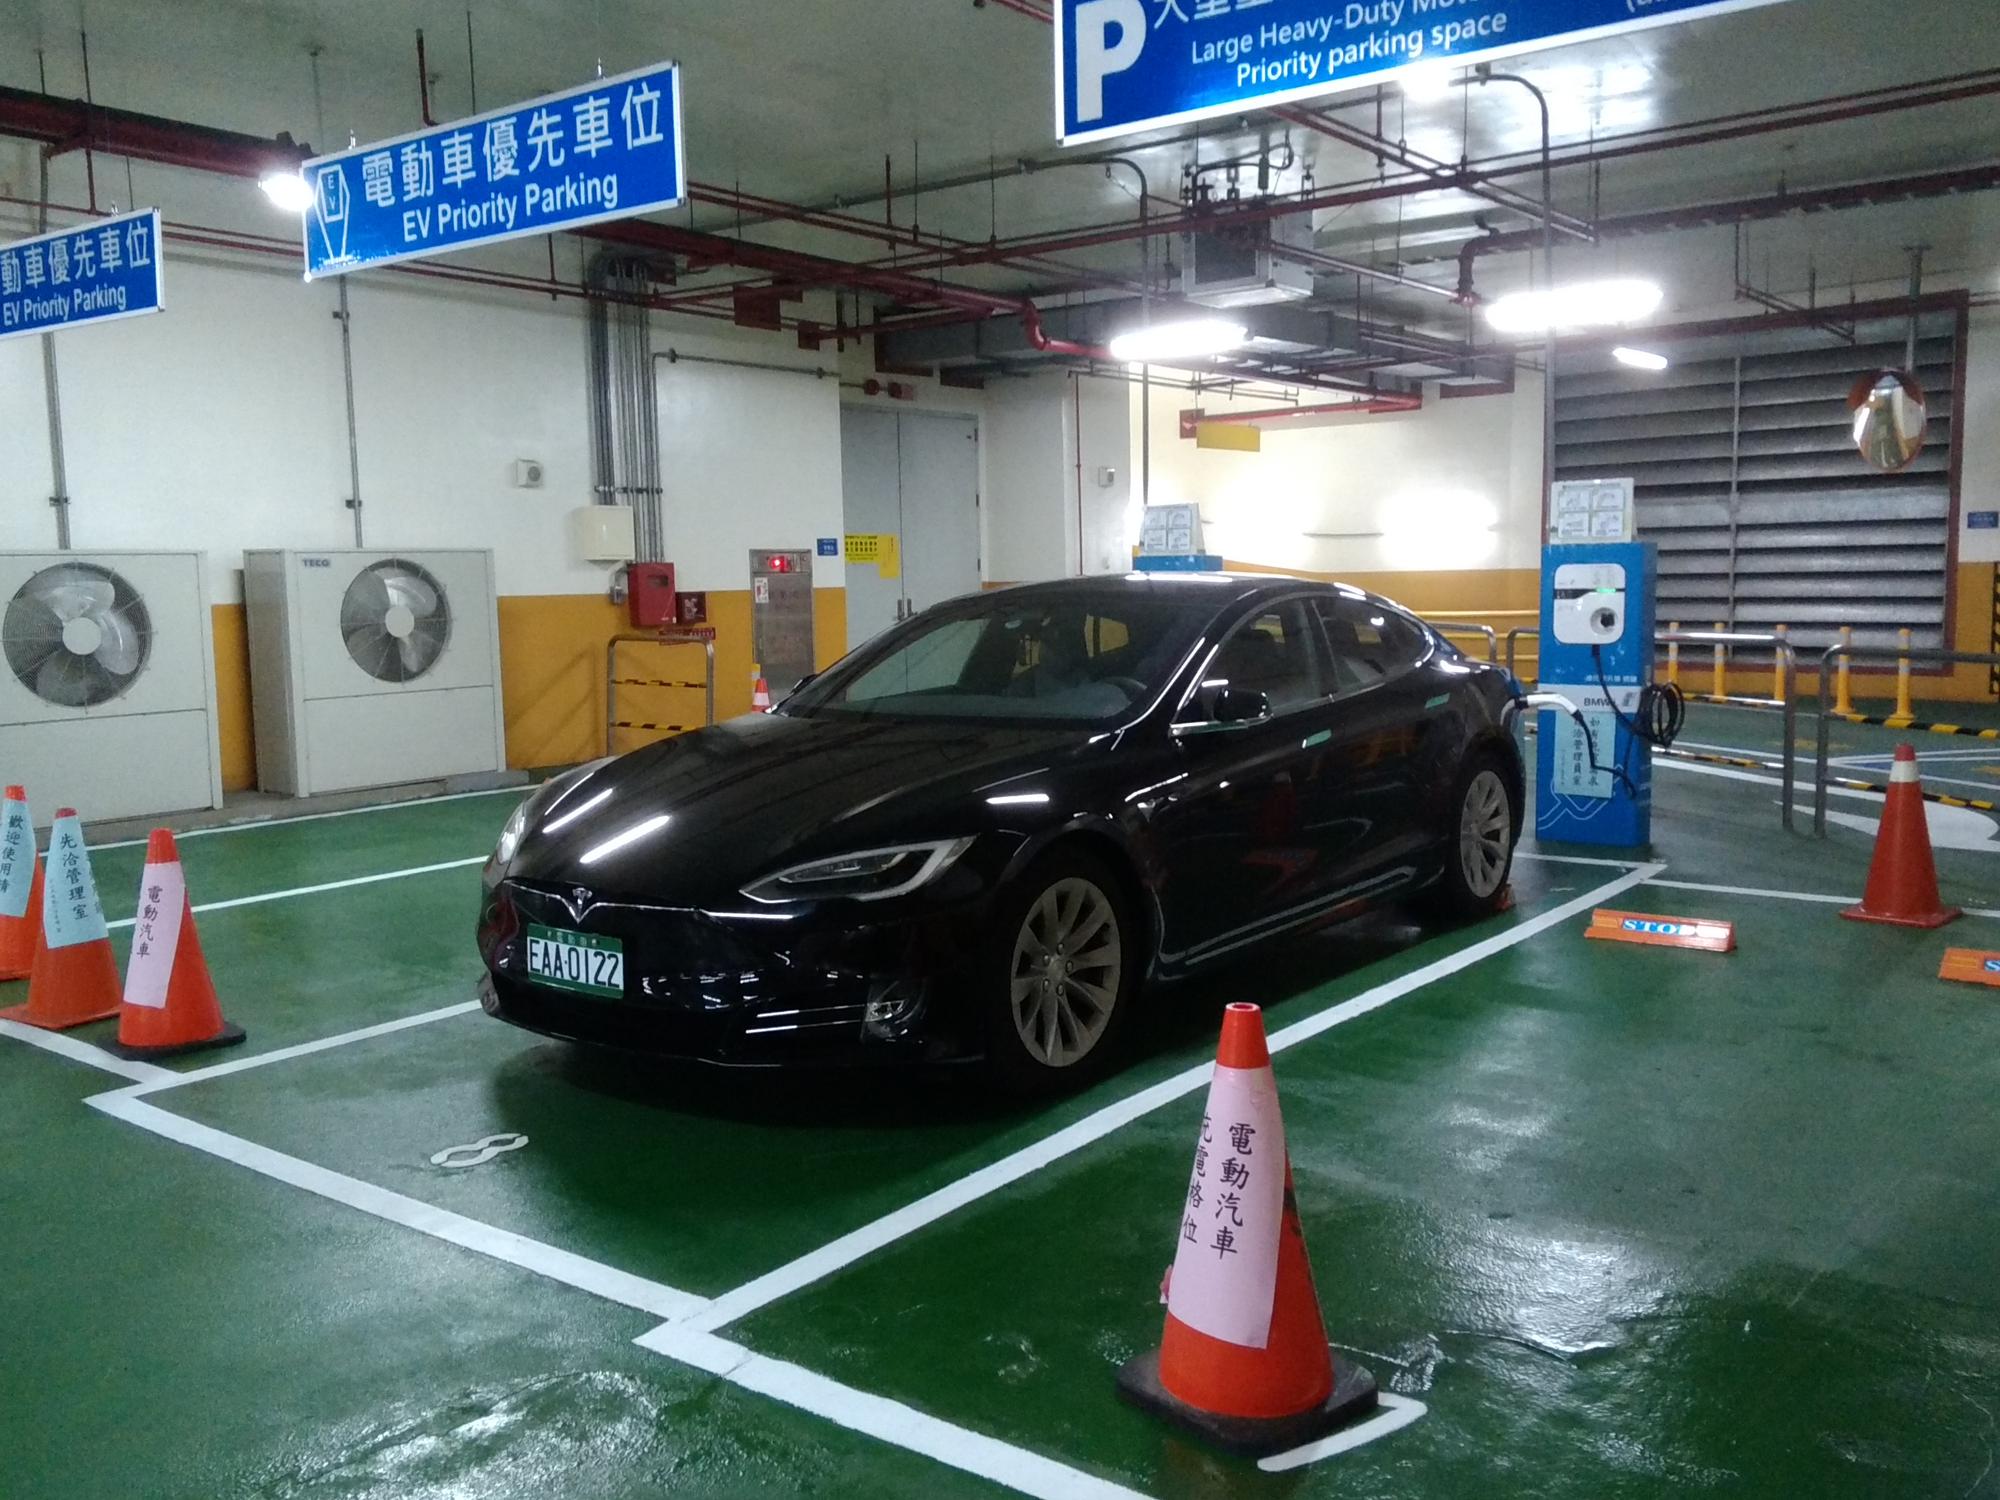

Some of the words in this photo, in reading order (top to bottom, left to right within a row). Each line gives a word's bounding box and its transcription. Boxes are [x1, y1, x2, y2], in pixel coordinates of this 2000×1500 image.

[1076, 0, 1147, 123] P
[1192, 28, 1253, 65] Large
[1260, 0, 1402, 49] Heavy-Duty
[1237, 50, 1322, 87] Priority
[1328, 29, 1423, 75] parking
[1431, 11, 1508, 47] space
[362, 81, 664, 208] 電動車優先車位
[402, 206, 432, 243] EV
[439, 189, 518, 235] Priority
[525, 172, 618, 218] Parking
[3, 301, 20, 326] EV
[24, 294, 70, 322] Priority
[73, 283, 126, 313] Parking
[60, 833, 89, 921] 先洽管理室
[136, 885, 163, 958] 電動汽車
[1210, 1122, 1256, 1259] 電動汽車
